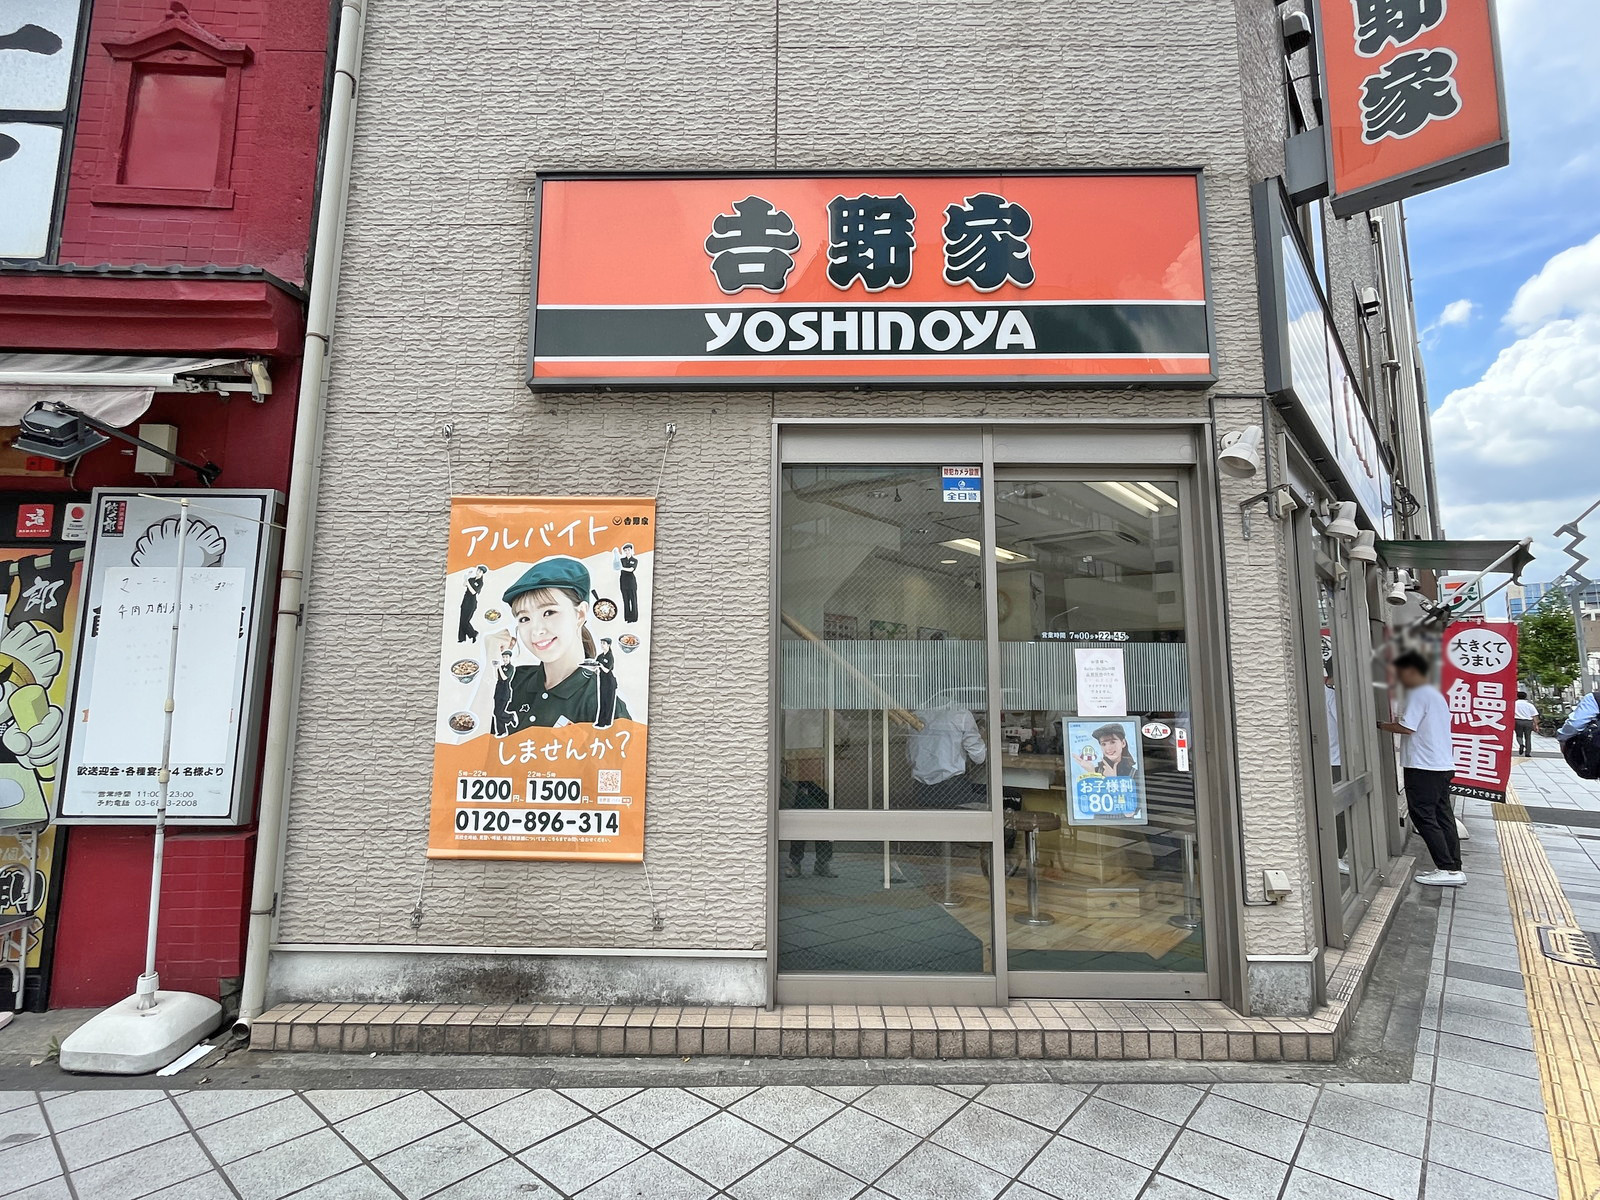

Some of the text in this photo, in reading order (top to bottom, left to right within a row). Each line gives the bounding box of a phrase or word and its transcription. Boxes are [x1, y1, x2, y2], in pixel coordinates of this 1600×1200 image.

[704, 193, 1036, 294] 吉野家
[704, 309, 1036, 353] YOSHINOYA
[623, 516, 649, 526] 吉野家
[461, 516, 608, 557] アルバイト
[1451, 638, 1507, 654] 大きくて
[1459, 654, 1501, 668] うまい
[1447, 678, 1507, 785] 鰻重
[497, 730, 632, 766] しませんか？
[1080, 779, 1133, 793] お子様割
[455, 810, 619, 834] 0120-896-314
